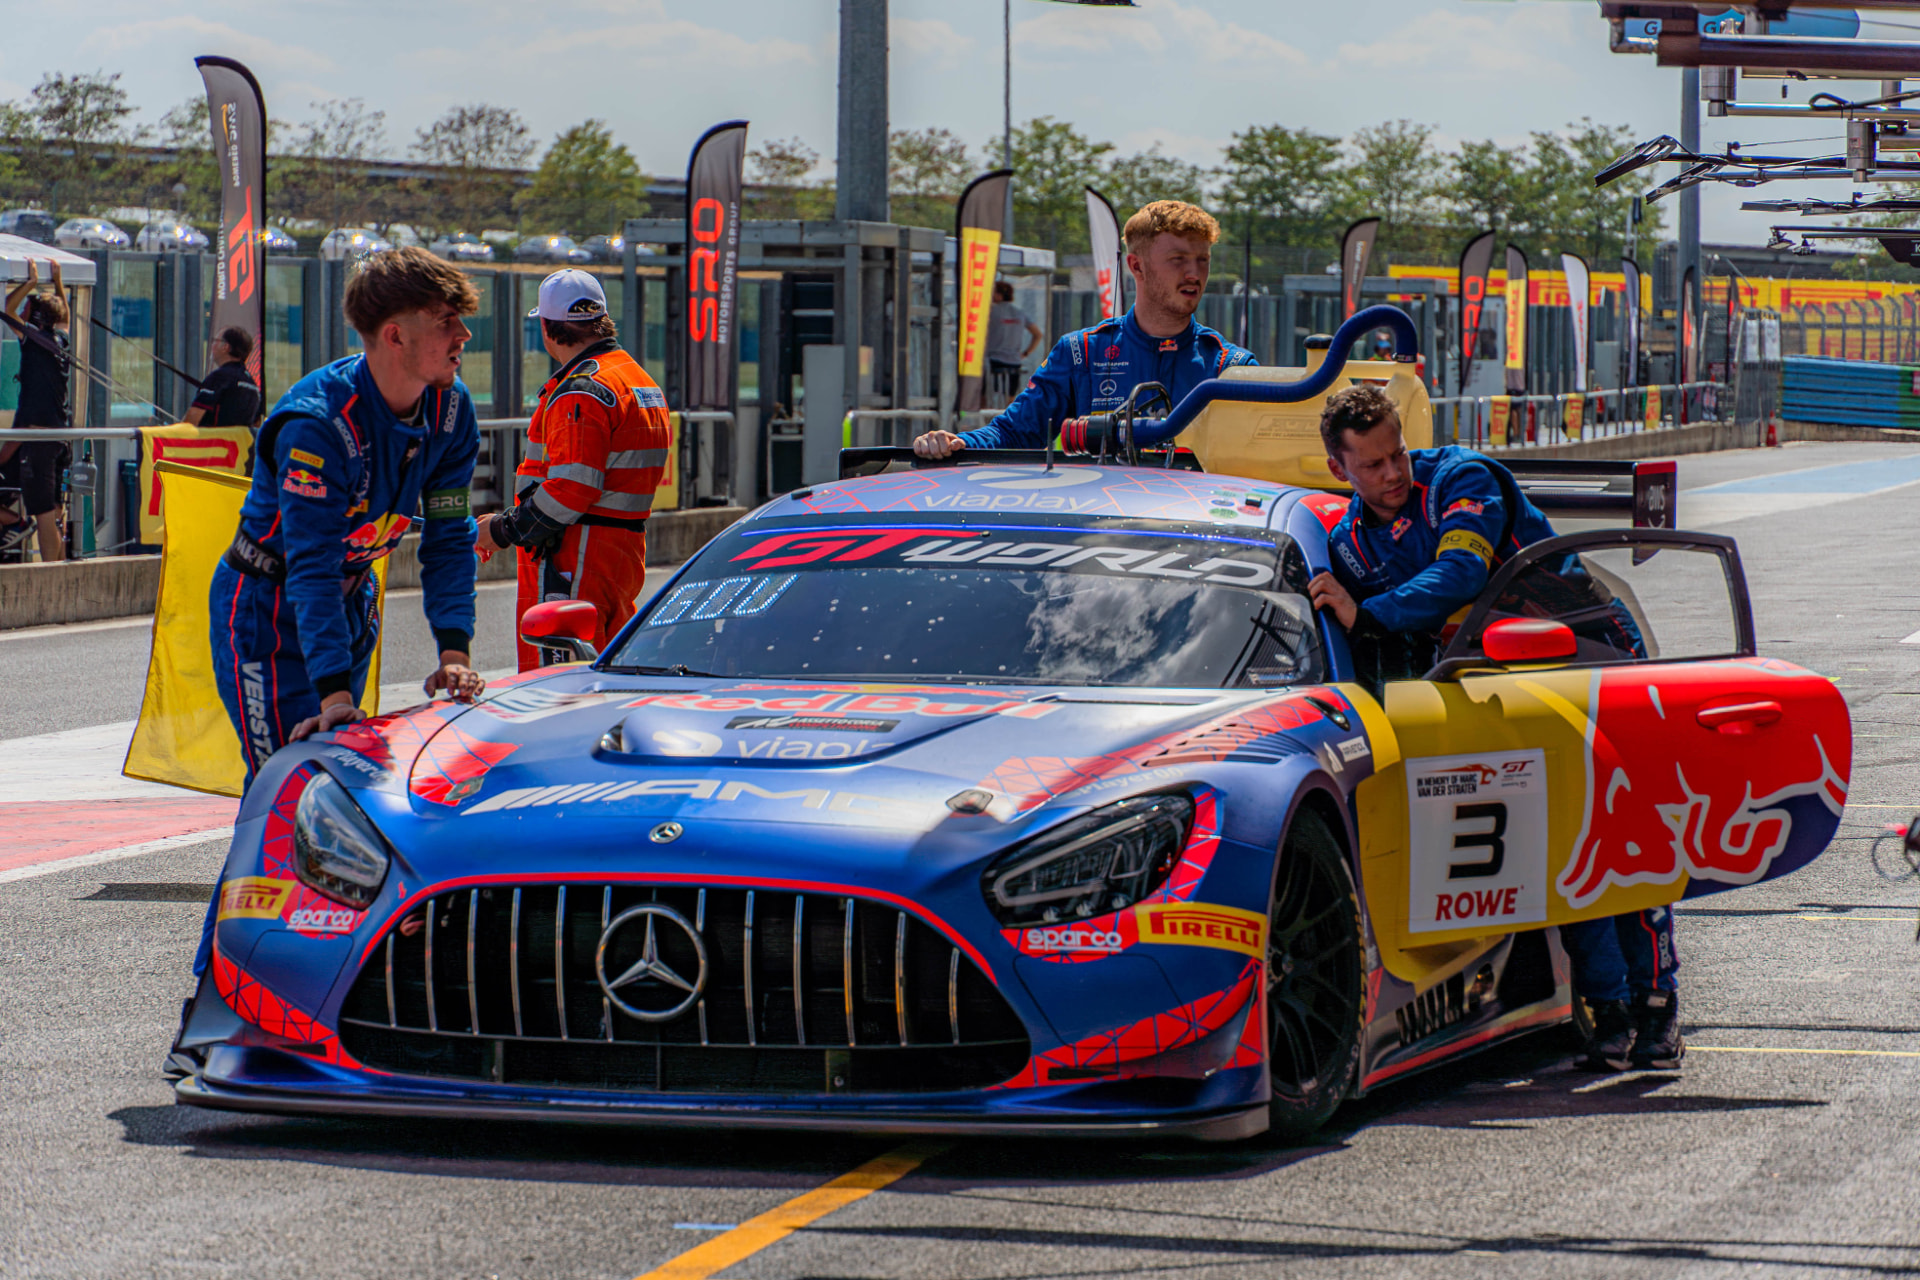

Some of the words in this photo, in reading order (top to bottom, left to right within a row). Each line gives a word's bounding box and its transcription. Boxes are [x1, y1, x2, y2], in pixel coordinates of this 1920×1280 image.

[689, 197, 725, 343] SRO
[717, 250, 736, 345] MOTORSPORTS
[727, 200, 739, 245] GROUP
[964, 241, 990, 363] PIRELLI
[1069, 335, 1083, 365] sparco
[443, 390, 460, 434] sparco
[332, 416, 357, 459] sparco
[283, 478, 305, 497] Red
[303, 482, 327, 498] Bull
[428, 494, 465, 510] SRO
[925, 491, 1098, 512] viaplay
[728, 528, 984, 571] GT
[900, 539, 1275, 587] WORLD
[1336, 541, 1366, 579] sparco
[622, 693, 852, 713] Red
[840, 693, 1065, 719] Bull
[736, 736, 896, 759] viapl
[1416, 777, 1424, 786] IN
[1424, 776, 1450, 786] MEMORY
[1459, 774, 1477, 783] MARC
[1501, 760, 1535, 773] GT
[1417, 787, 1432, 798] VAN
[1432, 786, 1446, 797] DER
[1447, 783, 1477, 796] STRATEN
[1447, 802, 1508, 880] 3
[220, 884, 283, 911] PIRELLI
[1434, 887, 1519, 922] ROWE
[287, 909, 355, 930] sparco
[1149, 910, 1260, 948] PIRELLI
[1027, 928, 1122, 952] sparco
